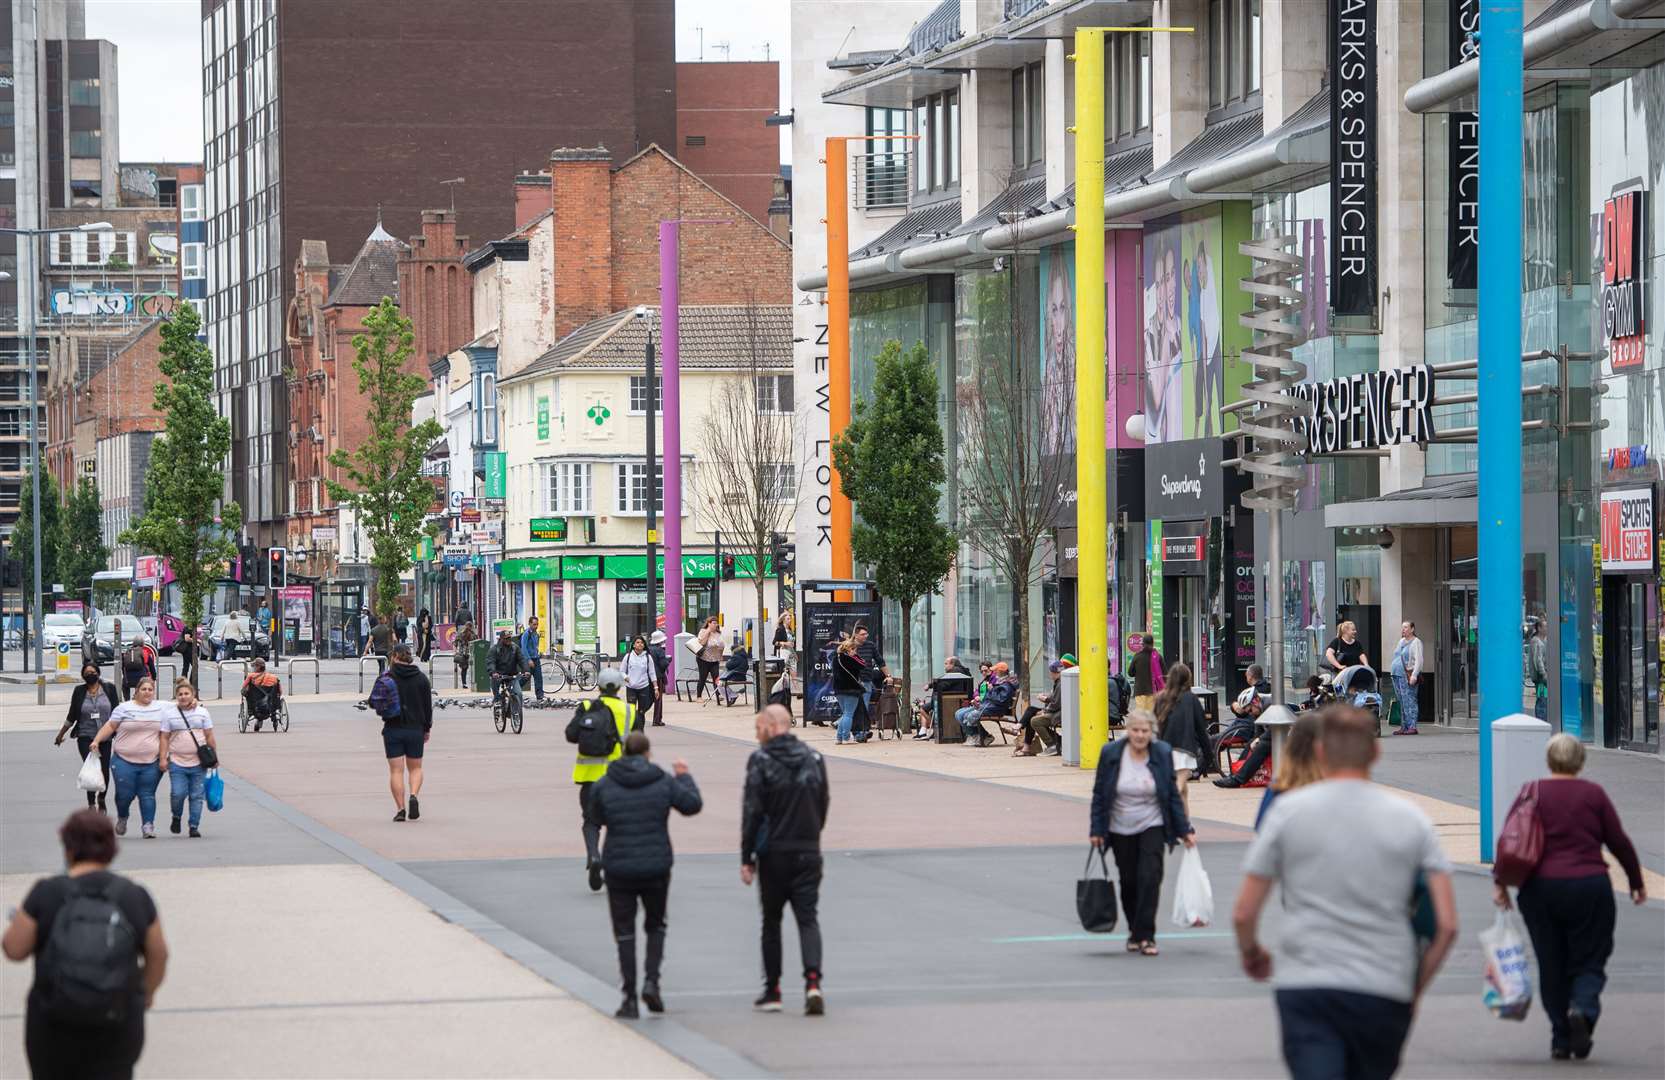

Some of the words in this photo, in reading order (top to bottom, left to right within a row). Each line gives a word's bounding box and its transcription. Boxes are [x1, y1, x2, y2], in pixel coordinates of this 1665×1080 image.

[1341, 0, 1366, 80] ARKS
[1341, 89, 1365, 109] &
[1341, 117, 1366, 276] SPENCER
[1459, 101, 1479, 246] ENCER
[1604, 193, 1634, 285] DW
[1604, 283, 1635, 340] GYM
[815, 324, 830, 413] NEW
[1612, 341, 1642, 364] GROUP
[1325, 364, 1433, 452] SPENCER
[816, 440, 832, 546] LOOK
[1161, 474, 1202, 499] Superdrug
[1621, 498, 1651, 528] SPORTS
[1625, 531, 1648, 560] STORE
